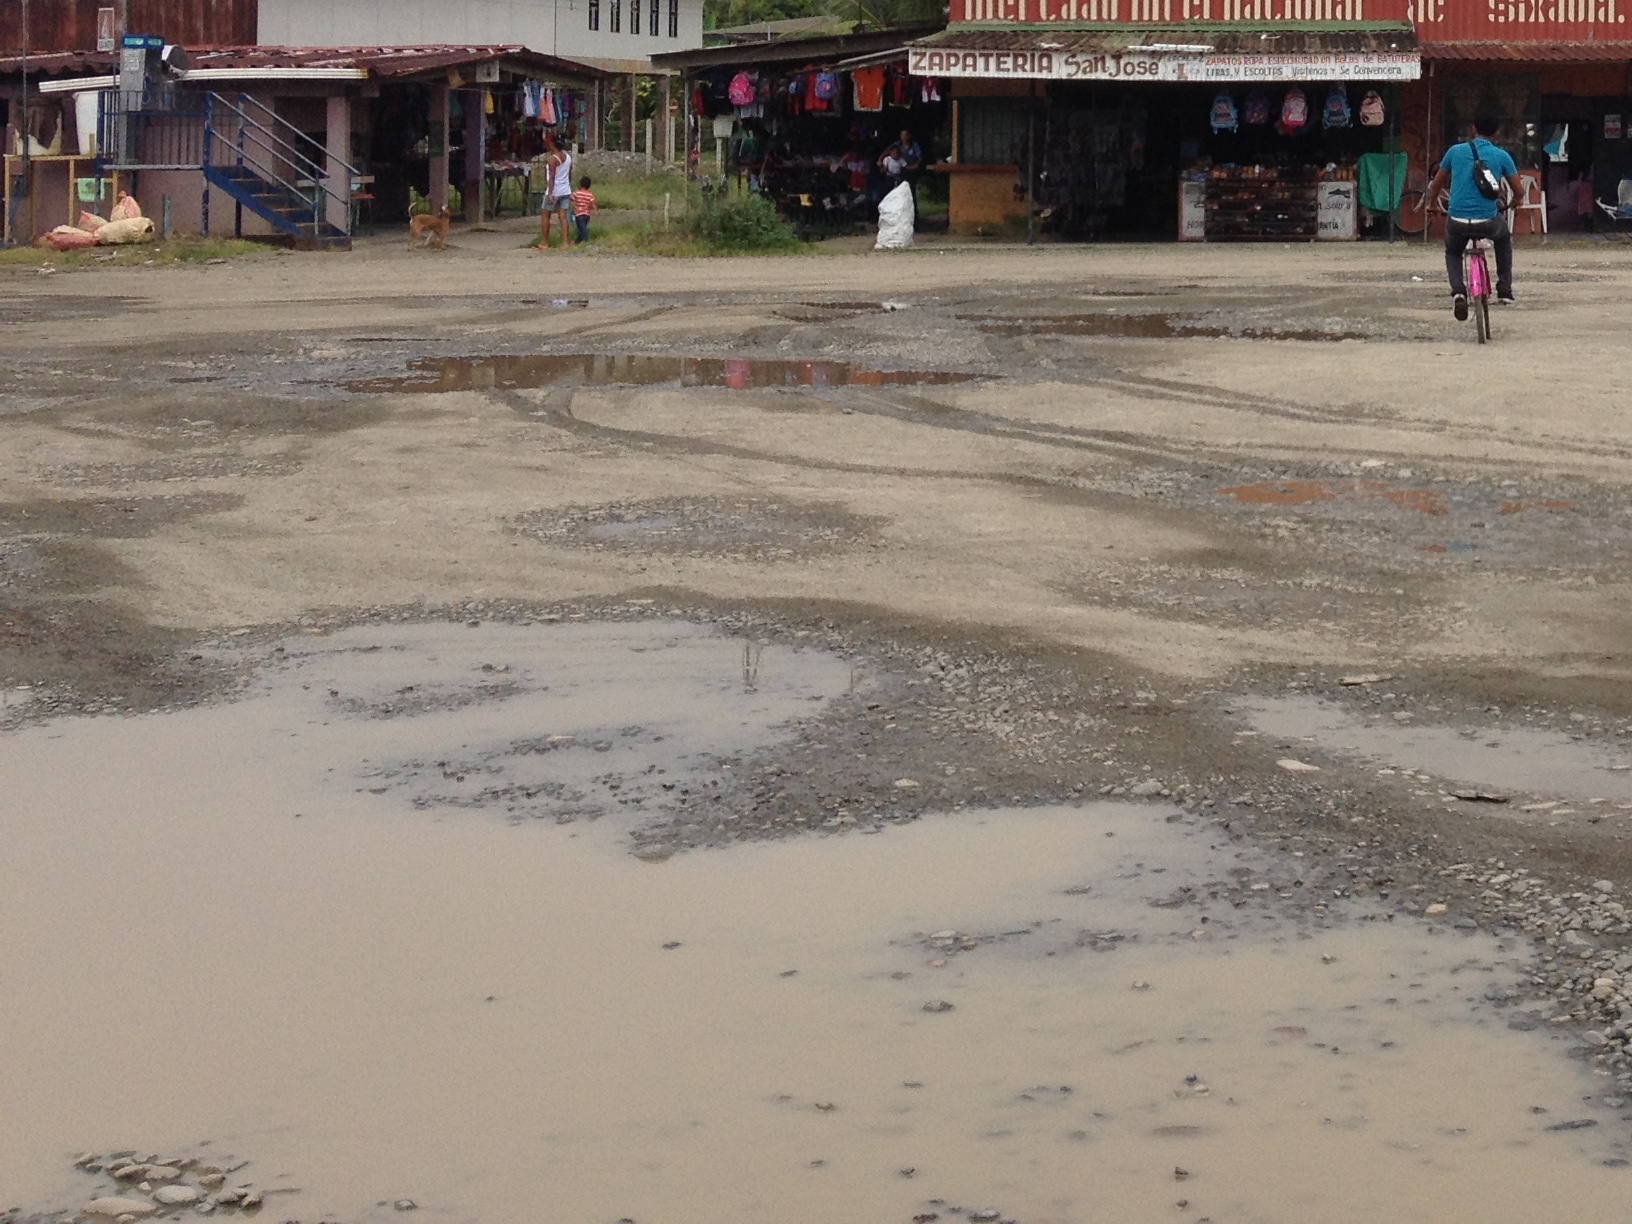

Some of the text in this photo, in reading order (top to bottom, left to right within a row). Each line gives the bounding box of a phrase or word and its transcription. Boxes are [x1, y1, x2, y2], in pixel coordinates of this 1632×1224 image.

[912, 51, 1053, 73] ZAPATERIA
[1064, 54, 1109, 77] San
[1205, 56, 1242, 66] ZAPATOS
[1244, 66, 1283, 76] ESCOLTAS
